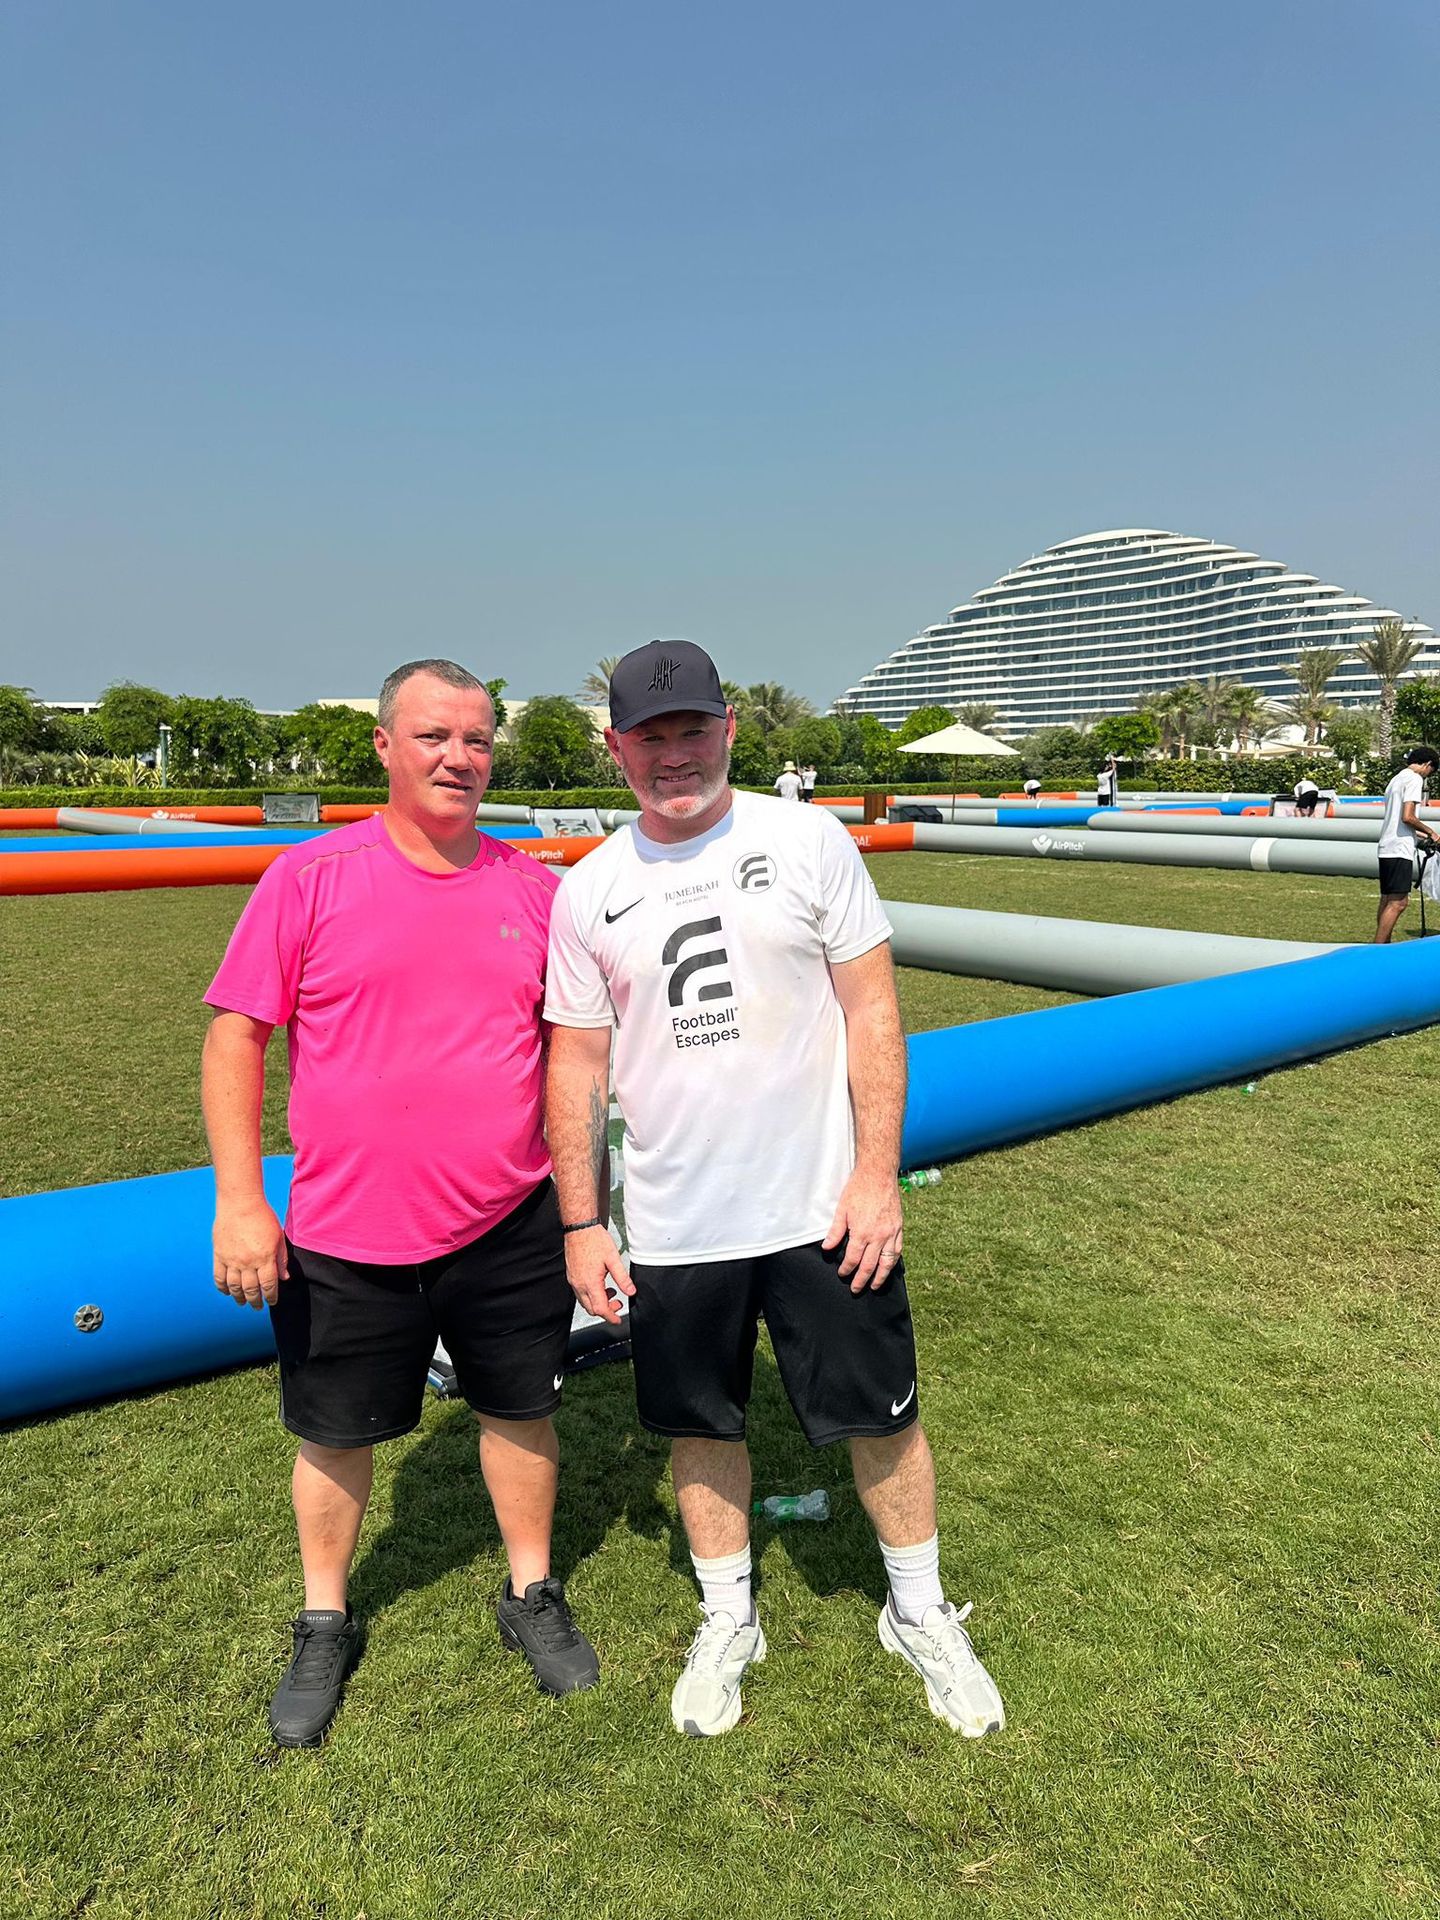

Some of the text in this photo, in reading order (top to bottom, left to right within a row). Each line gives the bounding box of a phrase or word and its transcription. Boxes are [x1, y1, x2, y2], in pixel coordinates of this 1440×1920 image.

[1052, 841, 1084, 851] AirPitch
[672, 1008, 735, 1031] Football
[675, 1028, 740, 1049] Escapes
